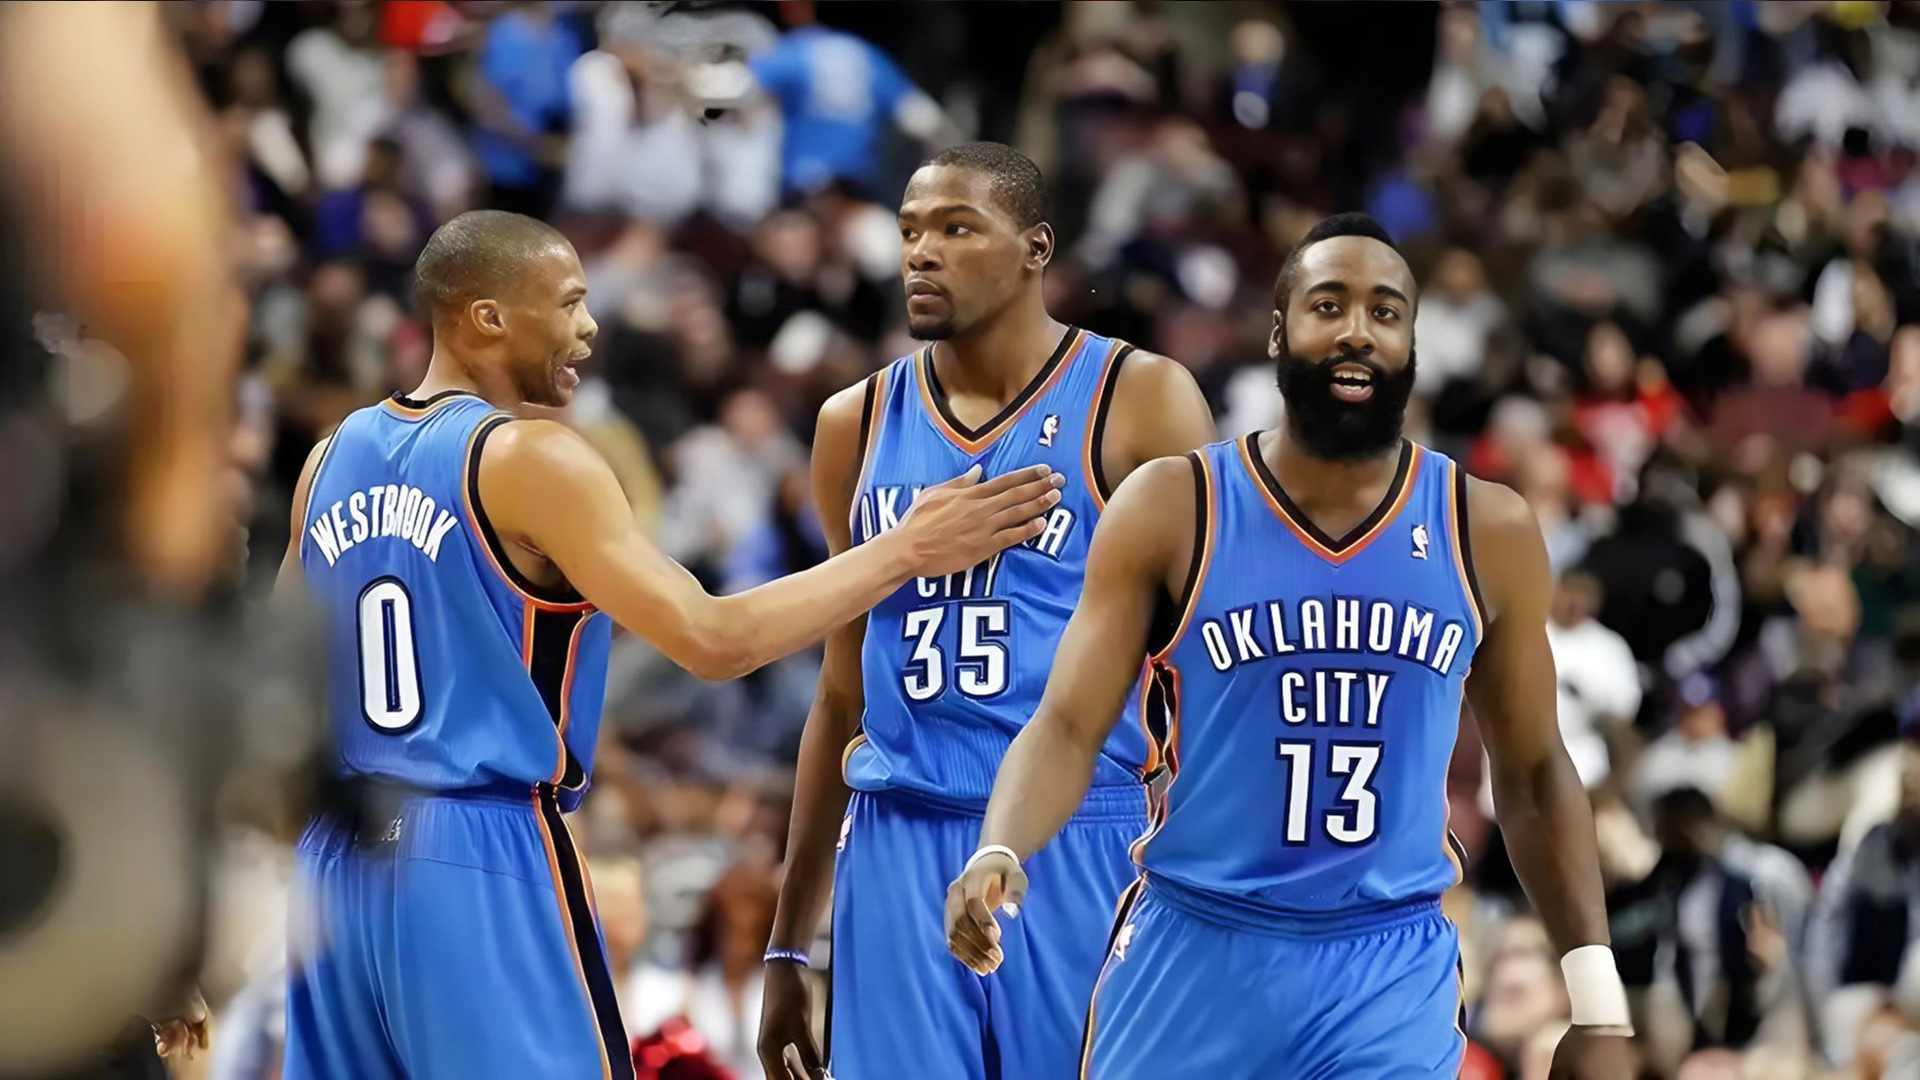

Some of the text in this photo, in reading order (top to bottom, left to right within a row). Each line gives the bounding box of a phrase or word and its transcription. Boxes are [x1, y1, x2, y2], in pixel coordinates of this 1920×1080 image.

[309, 483, 458, 568] WESTBROOK
[359, 578, 423, 732] 0
[903, 604, 1008, 701] 35
[1201, 599, 1464, 675] OKLAHOMA
[1281, 671, 1390, 725] CITY
[1278, 741, 1383, 844] 13
